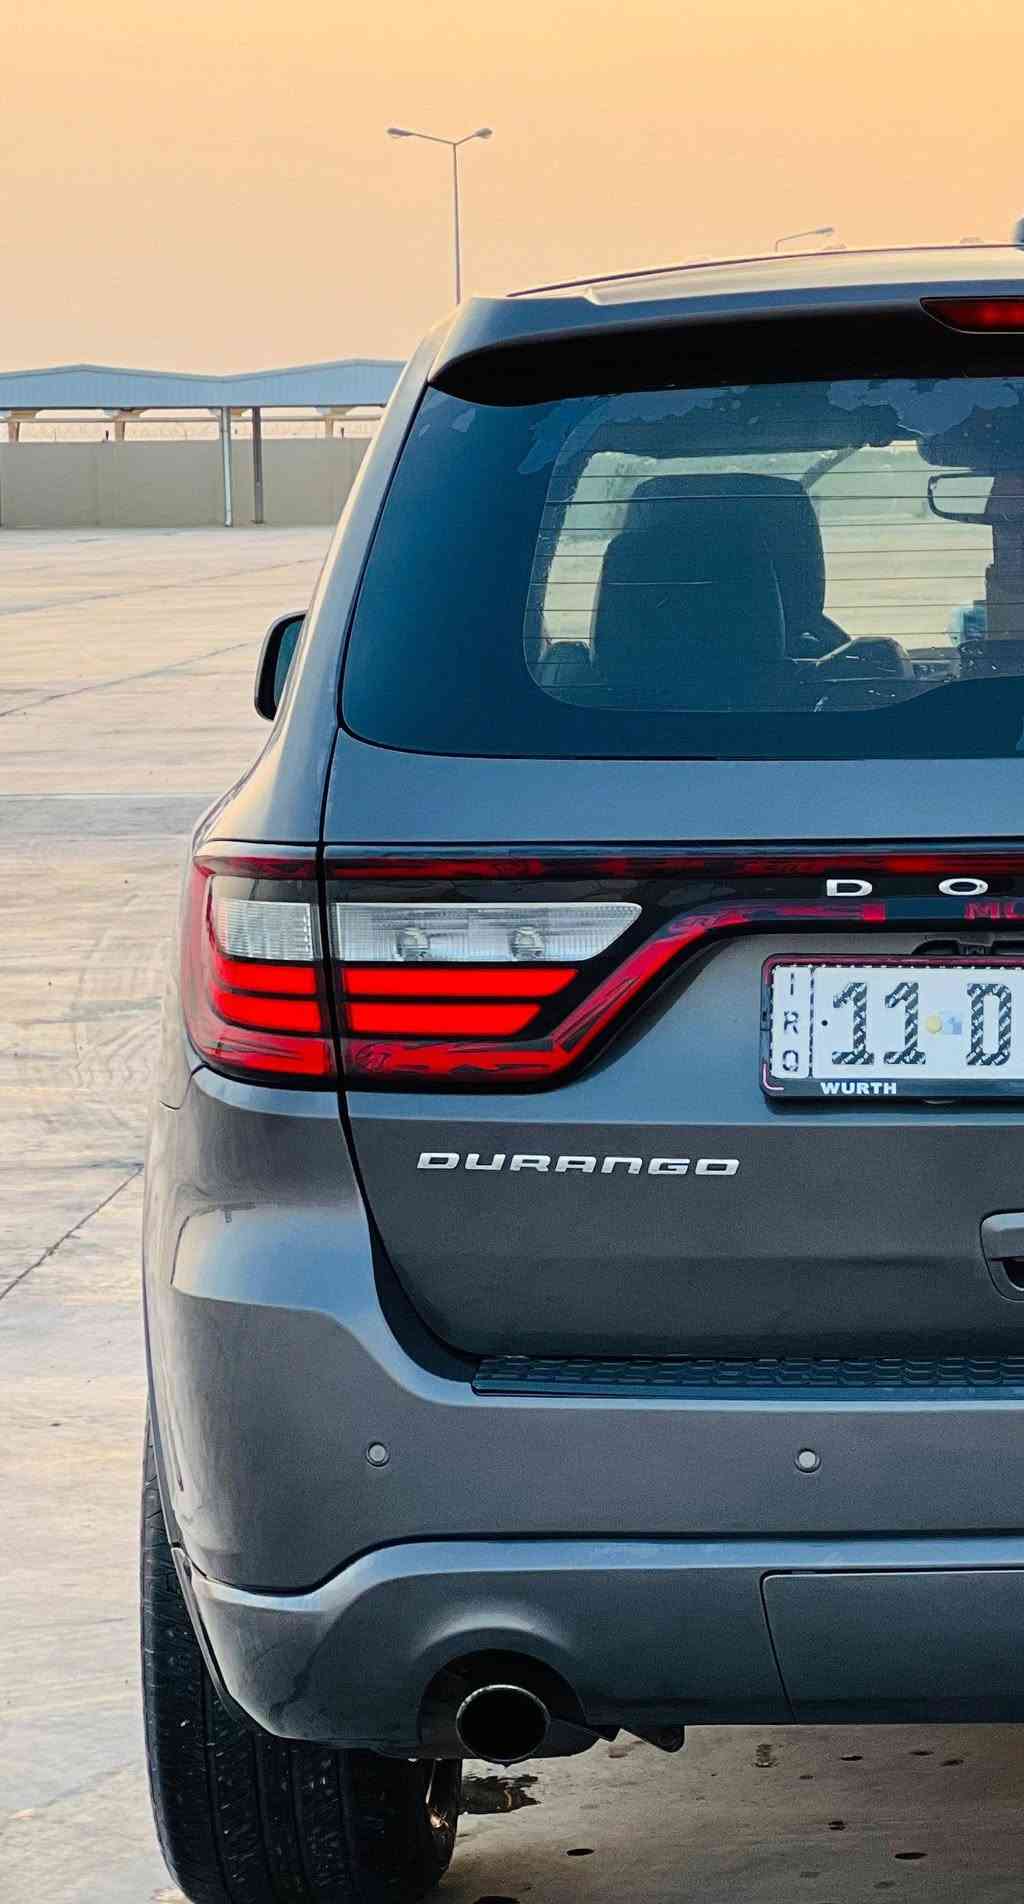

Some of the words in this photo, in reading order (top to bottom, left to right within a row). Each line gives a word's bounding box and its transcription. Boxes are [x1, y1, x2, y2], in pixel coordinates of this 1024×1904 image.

[832, 982, 926, 1065] 11
[966, 983, 1013, 1066] D
[820, 1082, 897, 1095] WURTH
[417, 1152, 739, 1175] DURANGO
